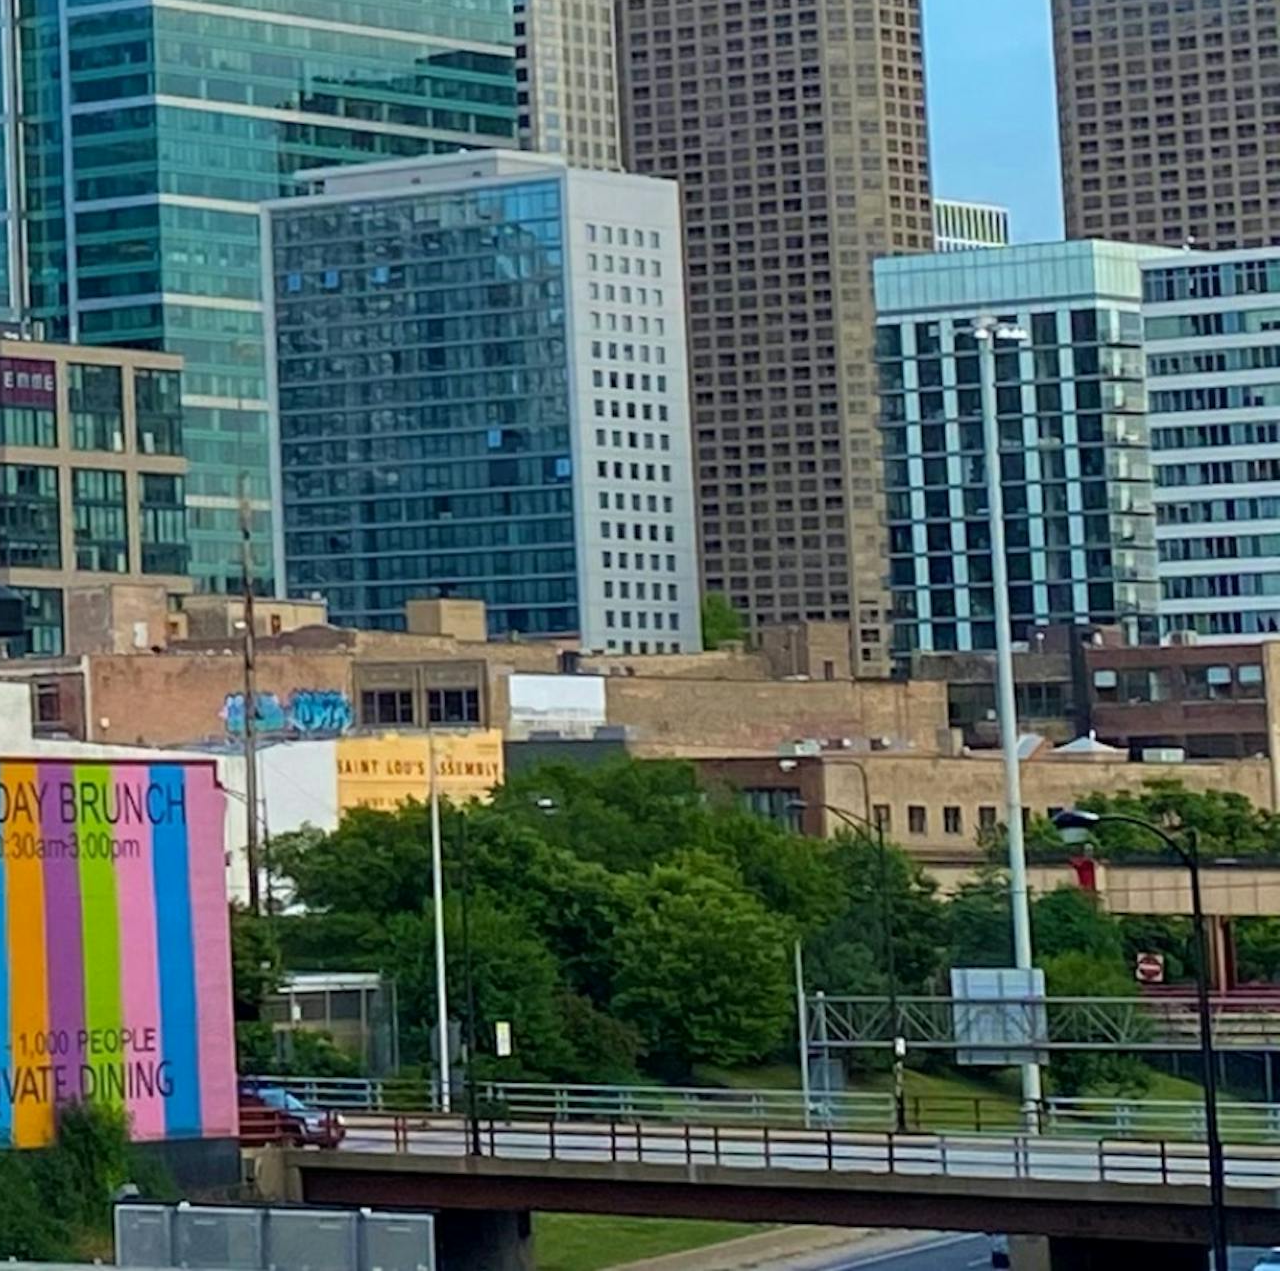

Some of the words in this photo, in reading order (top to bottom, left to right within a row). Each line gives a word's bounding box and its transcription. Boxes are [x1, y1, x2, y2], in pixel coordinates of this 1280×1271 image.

[337, 758, 378, 776] SAINT
[433, 760, 498, 776] SSEMBLY
[60, 782, 186, 825] BRUNCH
[20, 1029, 70, 1059] 1,000
[77, 1028, 156, 1055] PEOPLE
[79, 1059, 175, 1101] DINING
